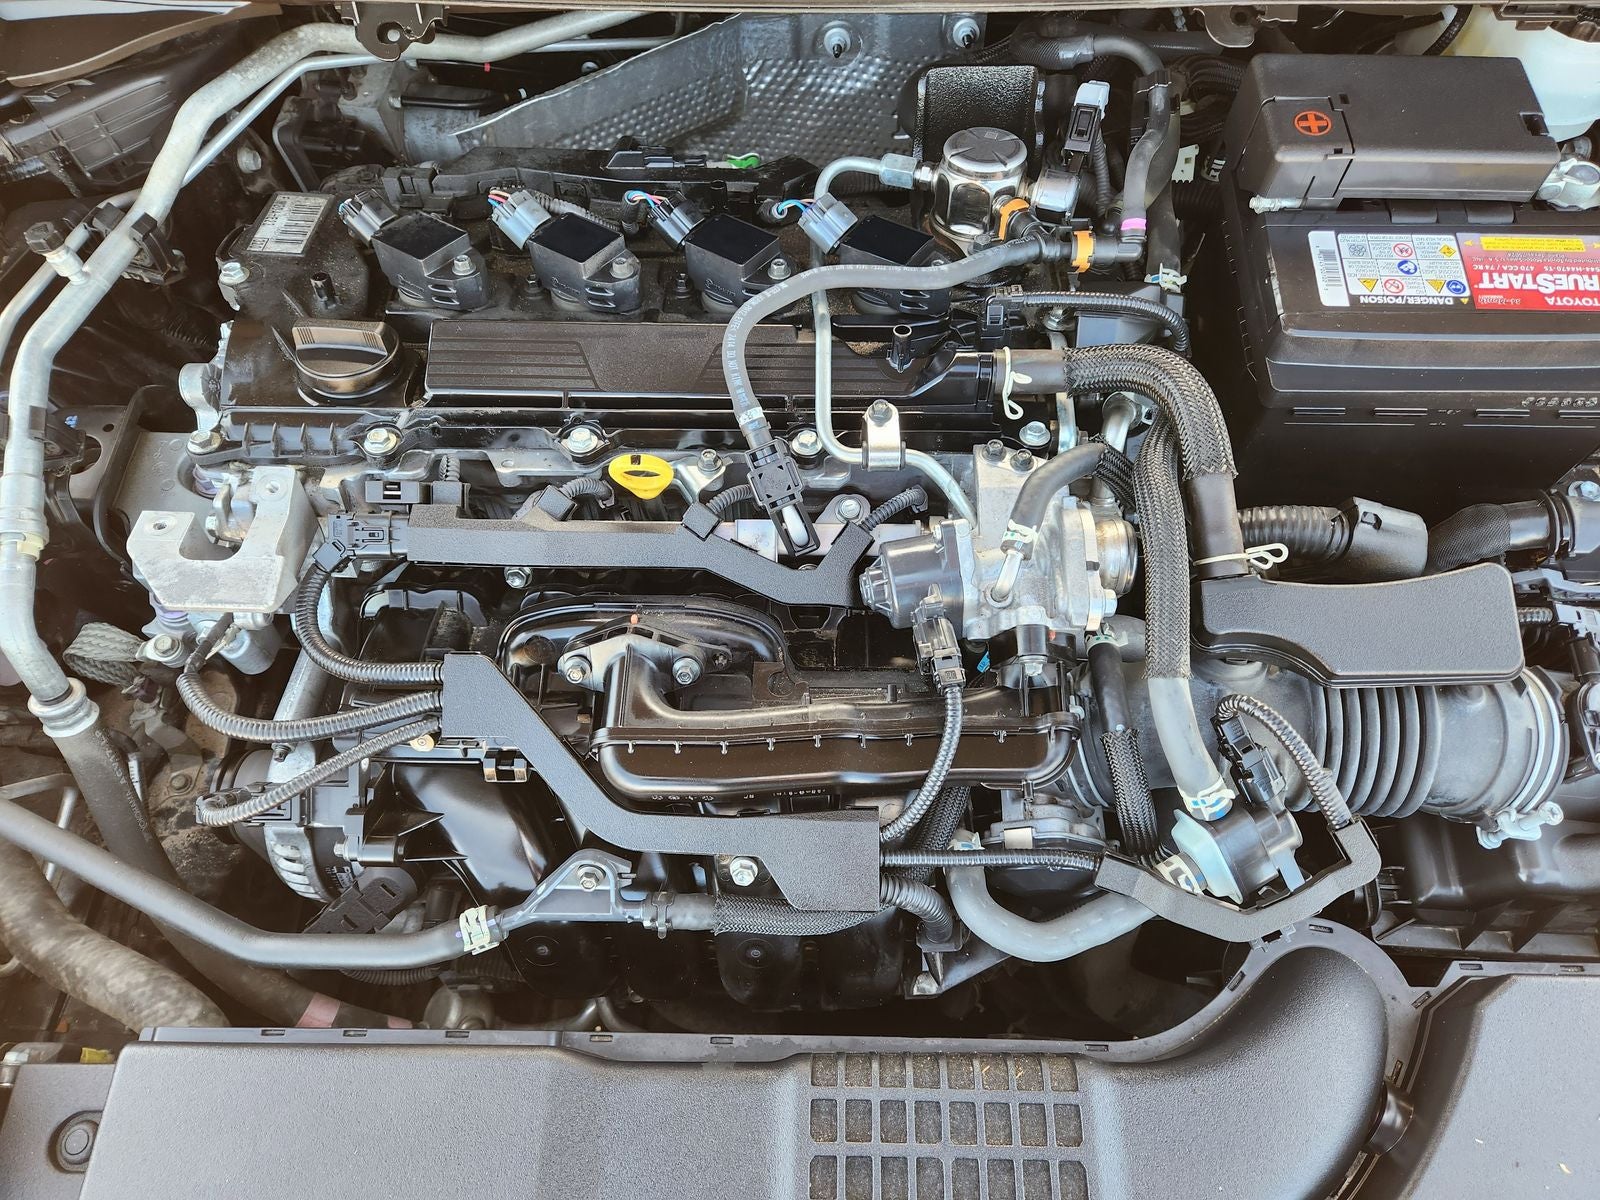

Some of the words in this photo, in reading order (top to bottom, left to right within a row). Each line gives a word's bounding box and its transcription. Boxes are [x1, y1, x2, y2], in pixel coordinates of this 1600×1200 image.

[1478, 273, 1600, 294] RUESTART
[1359, 295, 1454, 305] DANGER/POISON
[1545, 296, 1600, 307] TOYOTA
